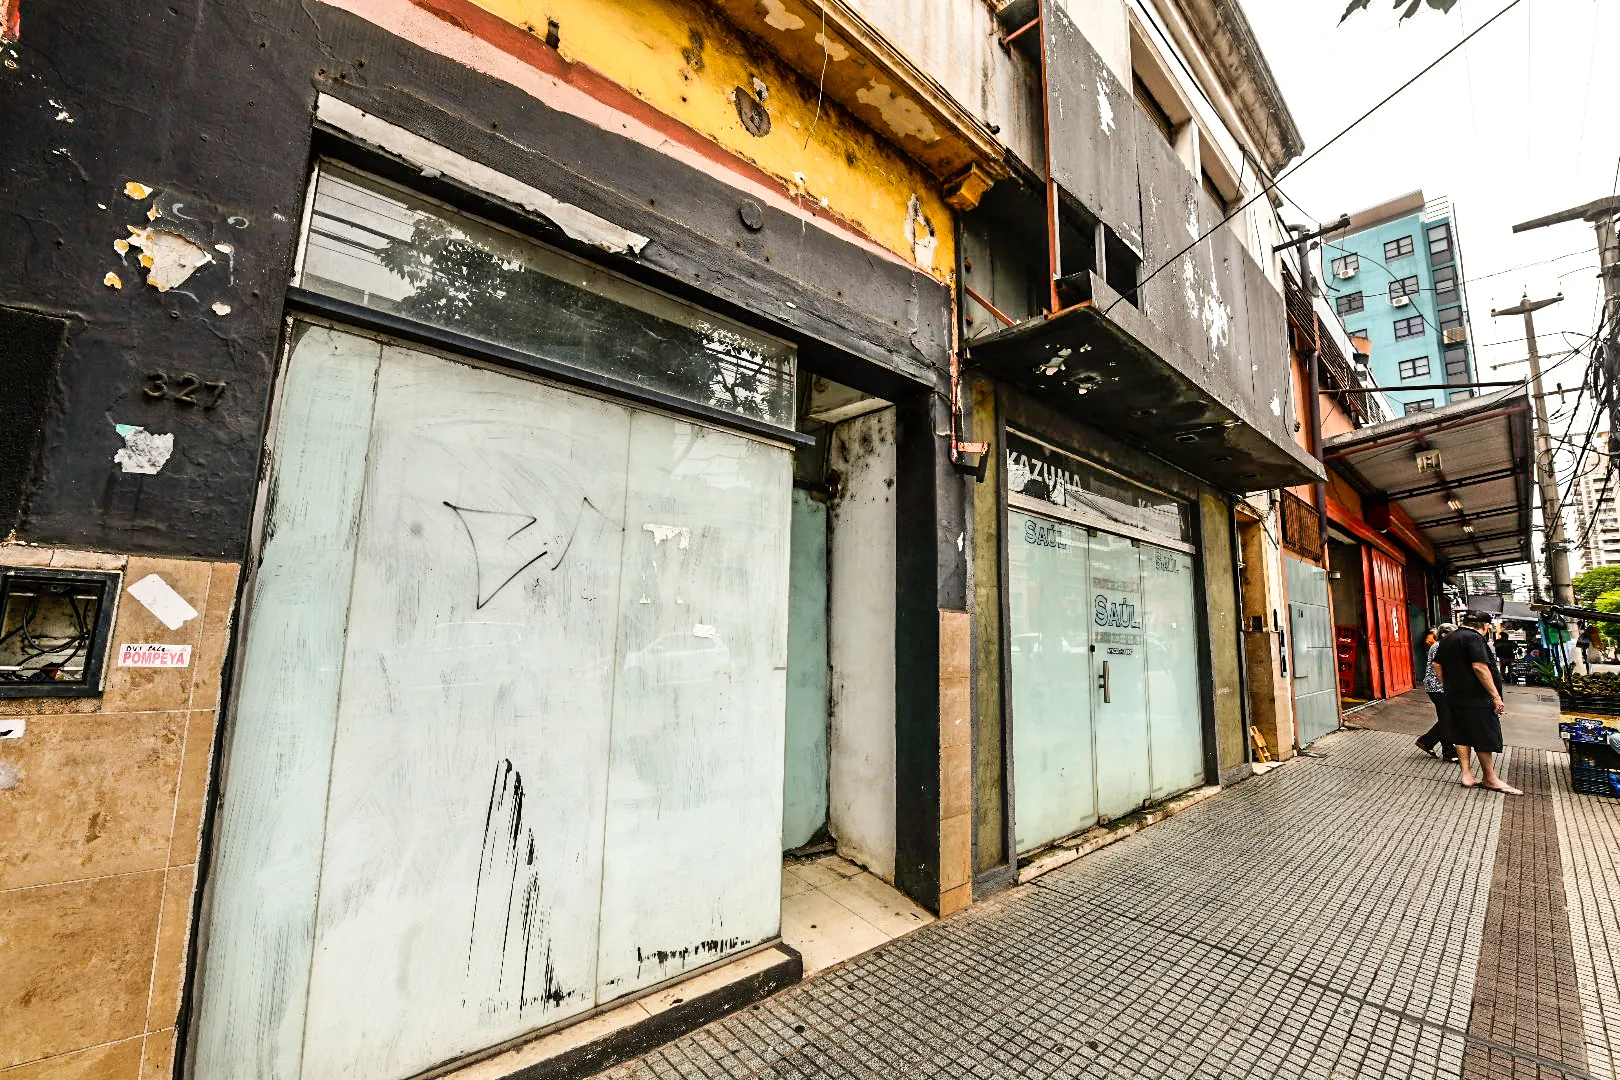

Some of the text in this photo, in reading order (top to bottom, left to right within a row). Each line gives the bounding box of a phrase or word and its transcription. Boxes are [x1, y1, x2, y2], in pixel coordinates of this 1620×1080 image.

[143, 371, 229, 409] 327
[1009, 451, 1082, 489] KAZUMA
[1024, 519, 1067, 550] SAÚL
[1094, 594, 1141, 630] SAÚL
[122, 652, 185, 665] POMPEYA
